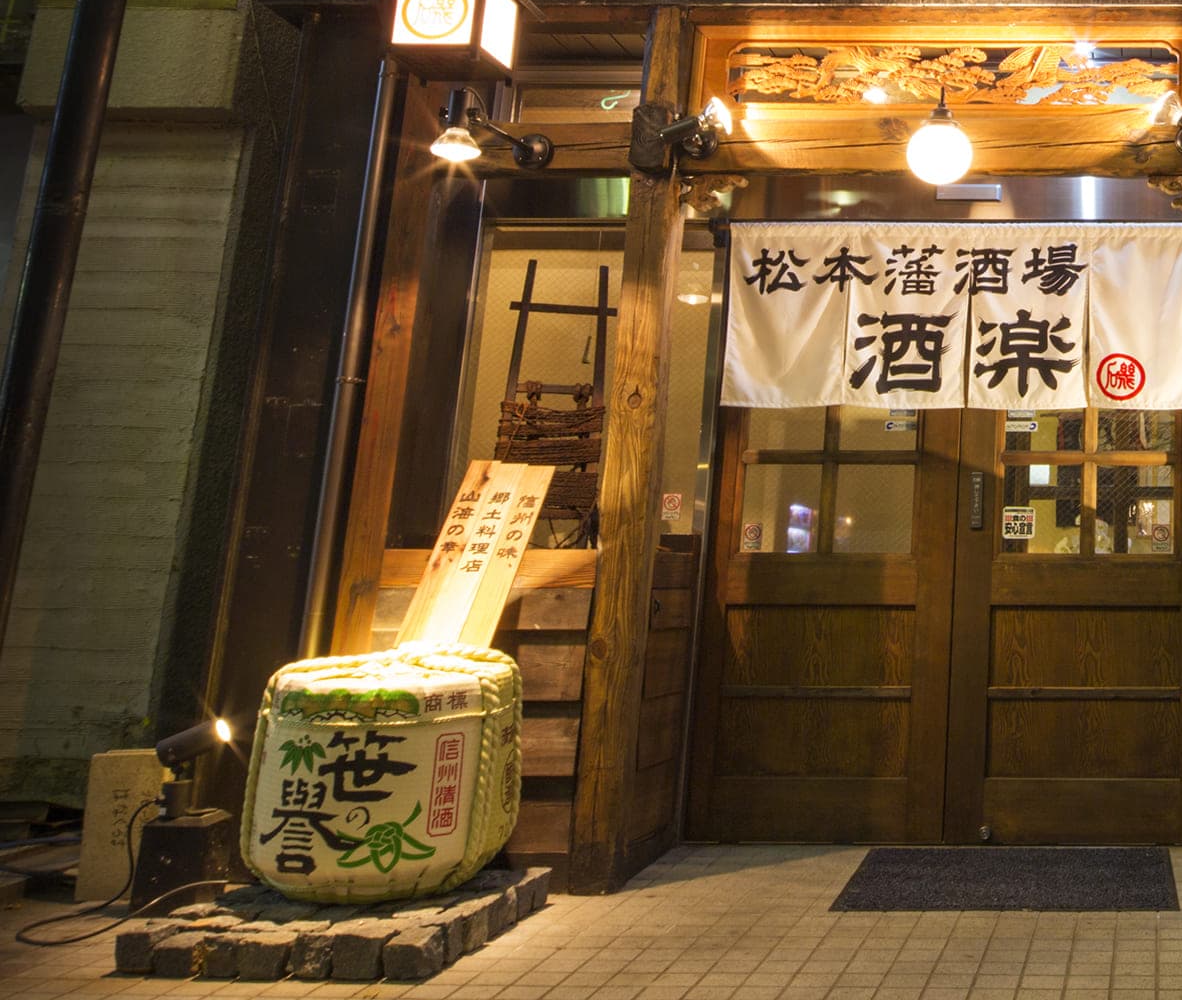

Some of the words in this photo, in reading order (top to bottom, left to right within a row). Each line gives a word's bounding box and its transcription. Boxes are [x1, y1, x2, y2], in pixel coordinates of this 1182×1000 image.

[744, 243, 1088, 297] 松本藩酒場
[849, 309, 1079, 398] 酒楽
[460, 491, 511, 572] 郷土料理店
[424, 691, 468, 713] 商標
[430, 738, 461, 829] 信州清酒
